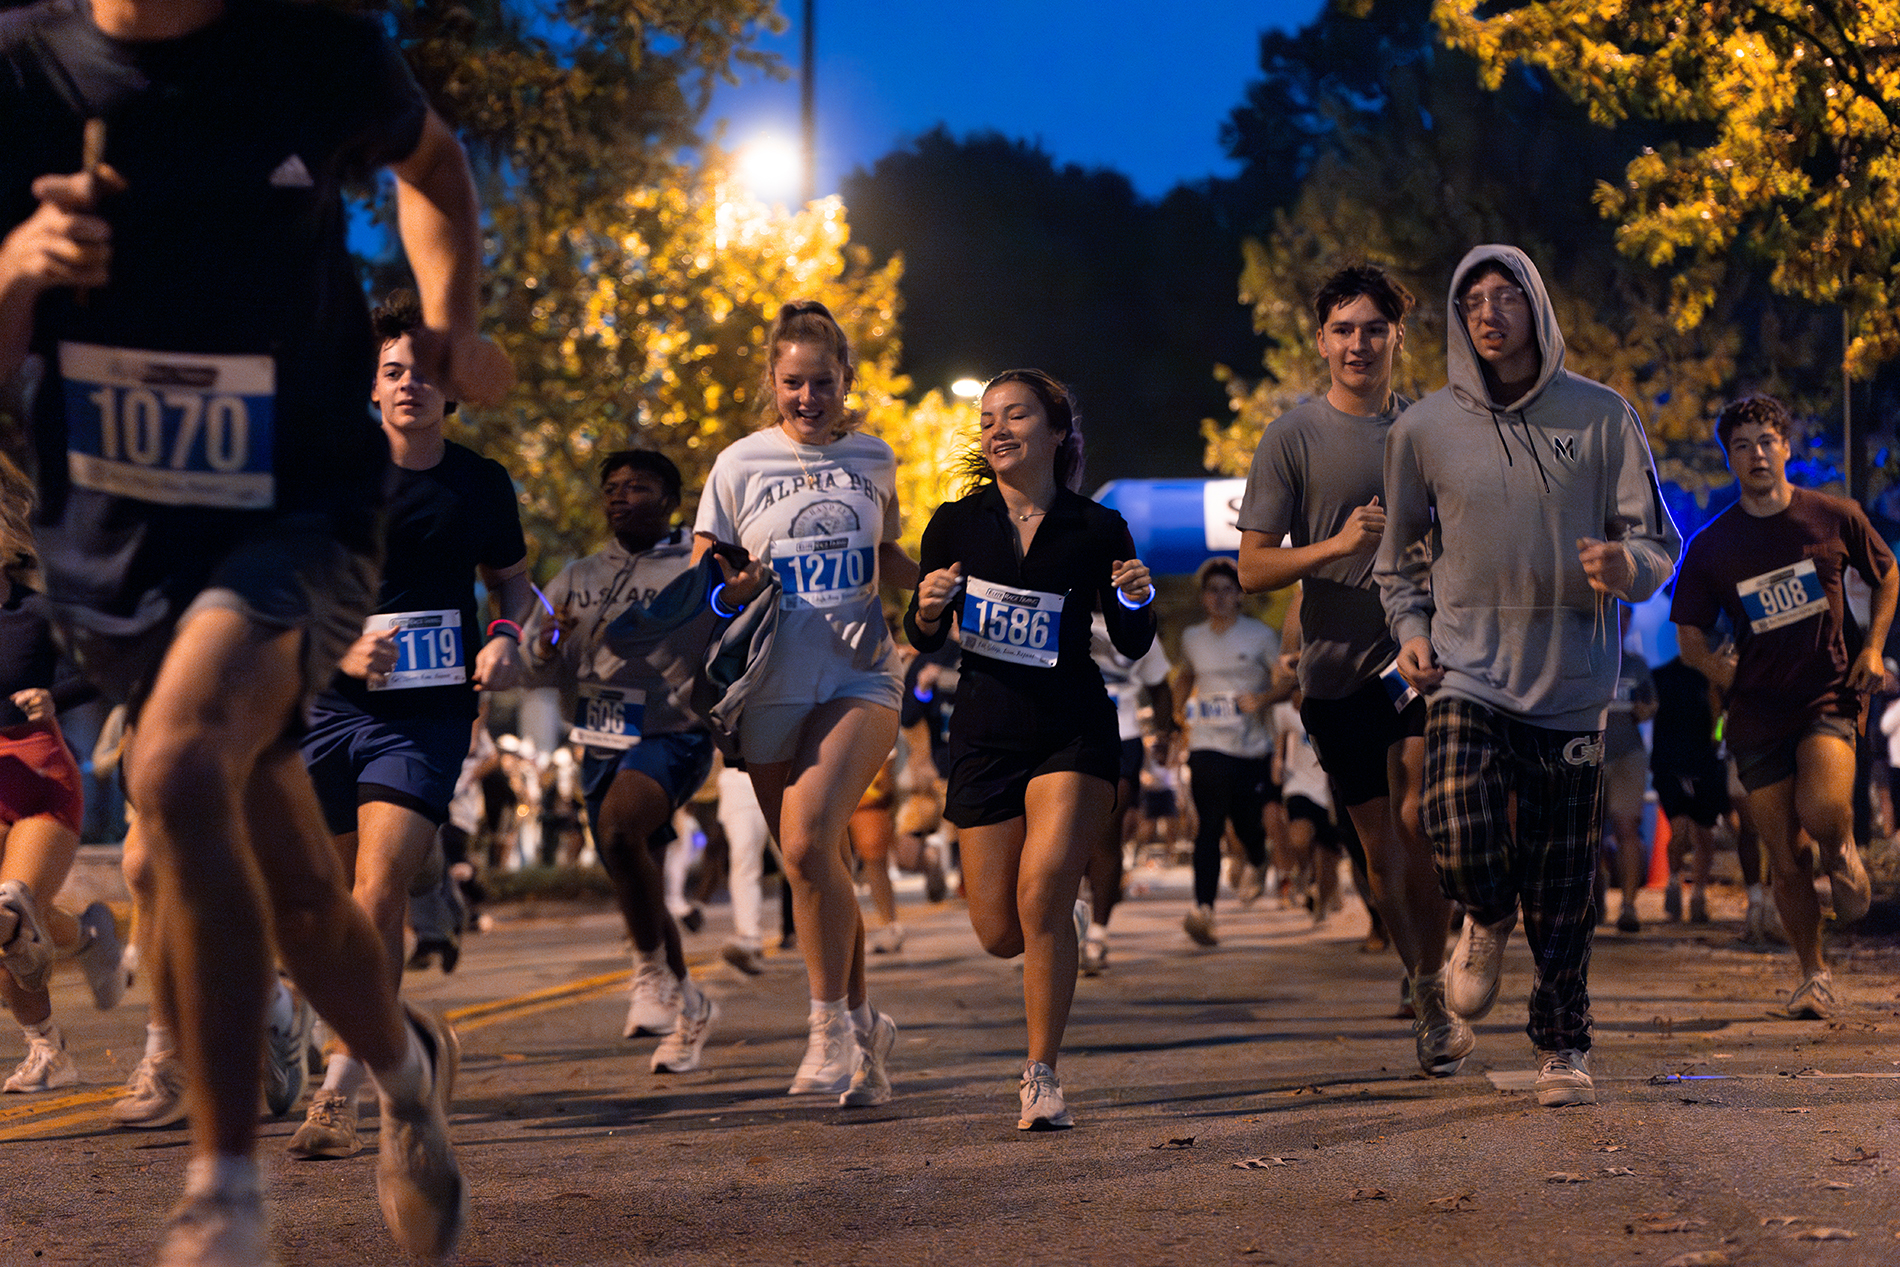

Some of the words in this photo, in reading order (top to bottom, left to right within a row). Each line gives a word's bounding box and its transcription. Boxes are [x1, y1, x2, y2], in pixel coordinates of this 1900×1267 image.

[89, 387, 249, 471] 1070
[762, 472, 840, 510] ALPHA
[848, 472, 879, 507] PHI
[788, 549, 865, 592] 1270
[1758, 577, 1808, 615] 908
[976, 600, 1050, 648] 1586
[401, 628, 457, 669] 119
